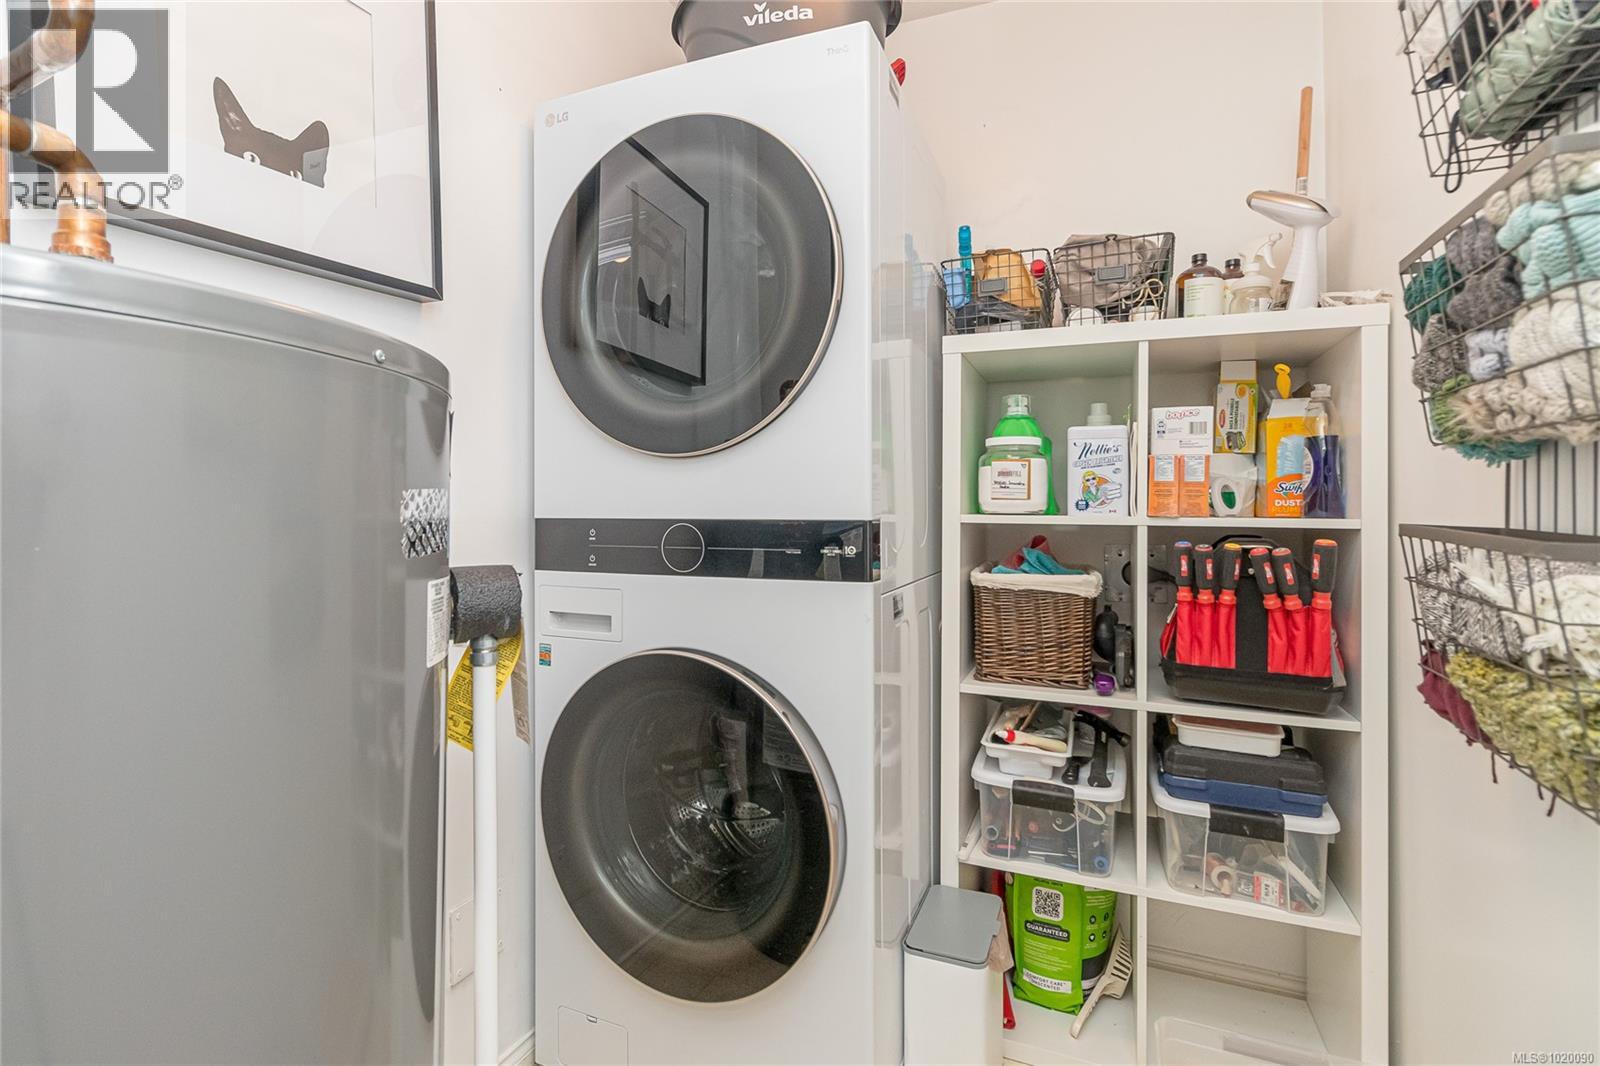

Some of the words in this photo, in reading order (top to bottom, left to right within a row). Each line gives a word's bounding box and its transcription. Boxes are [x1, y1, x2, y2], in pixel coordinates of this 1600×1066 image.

[743, 3, 814, 26] vileda
[556, 112, 569, 123] LG
[1074, 441, 1122, 460] Nellie's
[1026, 922, 1068, 938] GUARANTEED
